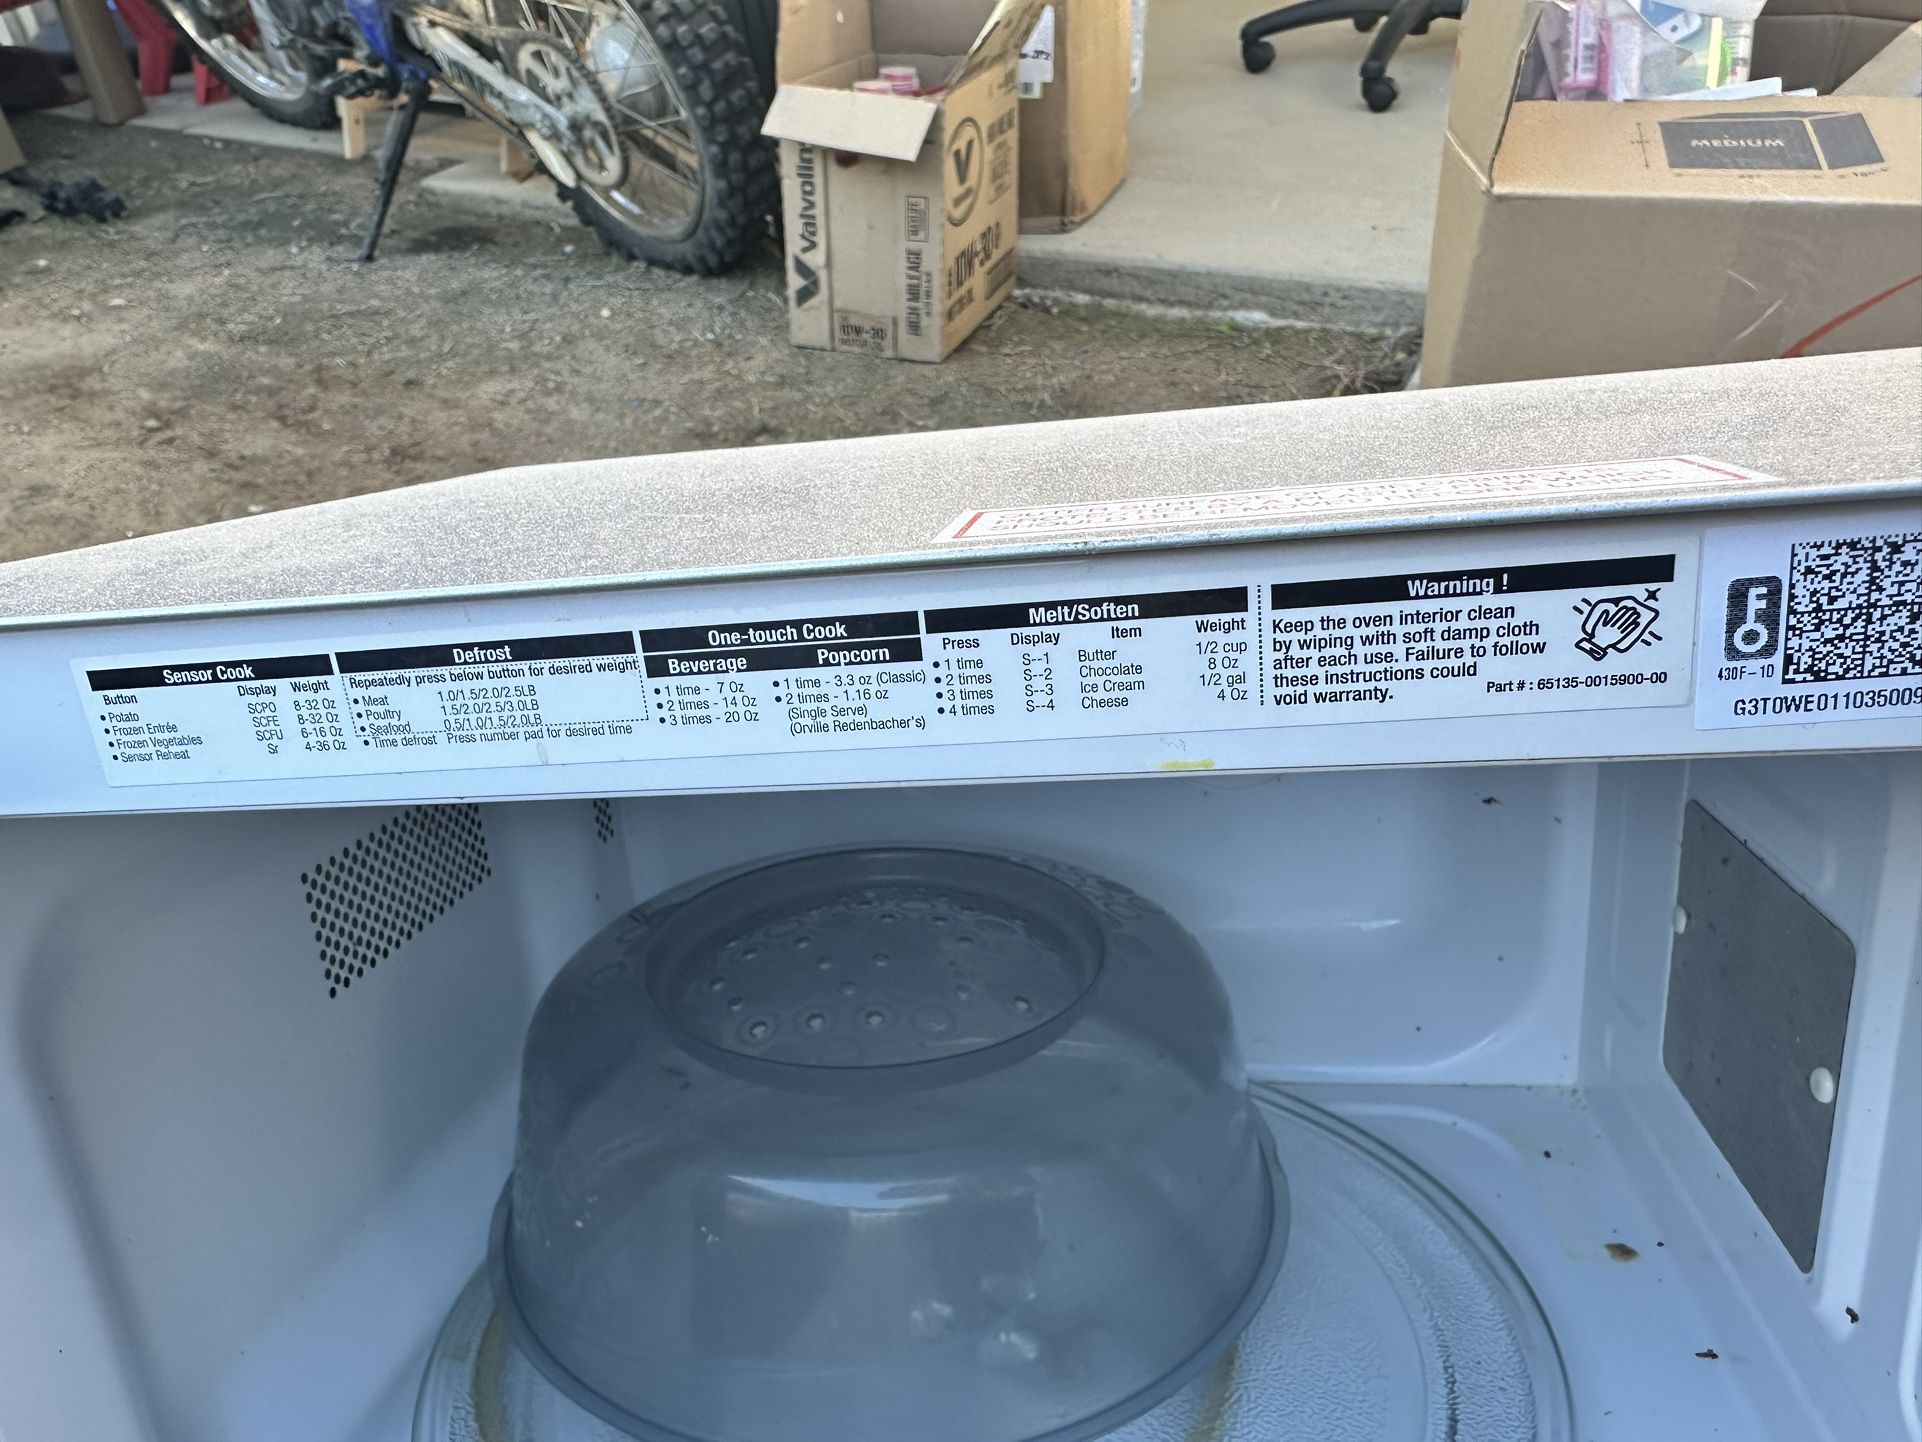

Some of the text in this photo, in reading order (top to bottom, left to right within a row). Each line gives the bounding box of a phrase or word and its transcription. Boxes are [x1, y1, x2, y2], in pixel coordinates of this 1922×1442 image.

[1690, 138, 1785, 149] MEDIUM
[1408, 574, 1508, 597] Warning !
[1029, 602, 1139, 624] Melt/Soften
[1272, 605, 1515, 635] Keep the oven interior clean
[1111, 625, 1142, 639] Item
[1195, 618, 1246, 634] Weight
[708, 622, 847, 646] One-touch Cook
[1011, 631, 1060, 647] Display
[1273, 621, 1539, 653] by wiping with soft damp cloth
[942, 637, 980, 650] Press
[1195, 641, 1247, 656] 1/2 cup
[453, 645, 512, 663] Defrost
[817, 647, 890, 666] Popcorn
[1078, 650, 1117, 662] Butter
[1273, 640, 1546, 670] after each use. Failure to follow
[668, 656, 747, 674] Beverage
[944, 657, 983, 670] 1 time
[1208, 656, 1238, 669] 8 Oz
[163, 664, 255, 684] Sensor Cook
[350, 659, 638, 689] Repeatedly press below button for desired weight
[1079, 663, 1143, 678] Chocolate
[1273, 662, 1477, 688] these instructions could
[783, 670, 926, 689] 1 time 3.3 oz (Classic)
[945, 672, 992, 685] 2 times
[1200, 672, 1246, 687] 1/2 gal
[1487, 671, 1667, 693] Part # 65135-0015900-00
[237, 684, 277, 698] Display
[291, 680, 330, 693] Weight
[438, 685, 536, 702] 1.0/1.5/2.0/2.5LB
[664, 681, 744, 696] 1 time 7 Oz
[948, 687, 993, 701] 3 times
[1080, 679, 1145, 694] Ice Cream
[103, 694, 138, 705] Button
[362, 695, 389, 706] Meat
[785, 690, 888, 704] 2 times 1.16 oz
[1217, 688, 1247, 701] 4 Oz
[1274, 688, 1393, 705] void warranty.
[248, 702, 276, 714] SCPO
[294, 699, 336, 711] 8-32 Oz
[441, 700, 539, 716] 1.5/2.0/2.5/3.0LB
[667, 696, 757, 711] 2 times 14 Oz
[949, 702, 995, 716] 4 times
[1081, 696, 1128, 709] Cheese
[109, 712, 139, 722] Potato
[298, 712, 340, 725] 8-32 Oz
[366, 708, 401, 721] Poultry
[670, 710, 759, 726] 3 times 20 Oz
[788, 704, 868, 721] (Single Serve)
[113, 721, 177, 736] Frozen Entrée
[301, 726, 343, 738] 6-16 Oz
[369, 722, 411, 735] Seafood
[448, 723, 632, 744] Press number pad for desired time
[790, 716, 925, 736] (Orville Redenbacher's)
[117, 735, 203, 749] Frozen Vegetables
[305, 739, 347, 752] 4-36 Oz
[372, 734, 437, 748] Time defrost
[121, 749, 190, 762] Sensor Reheat
